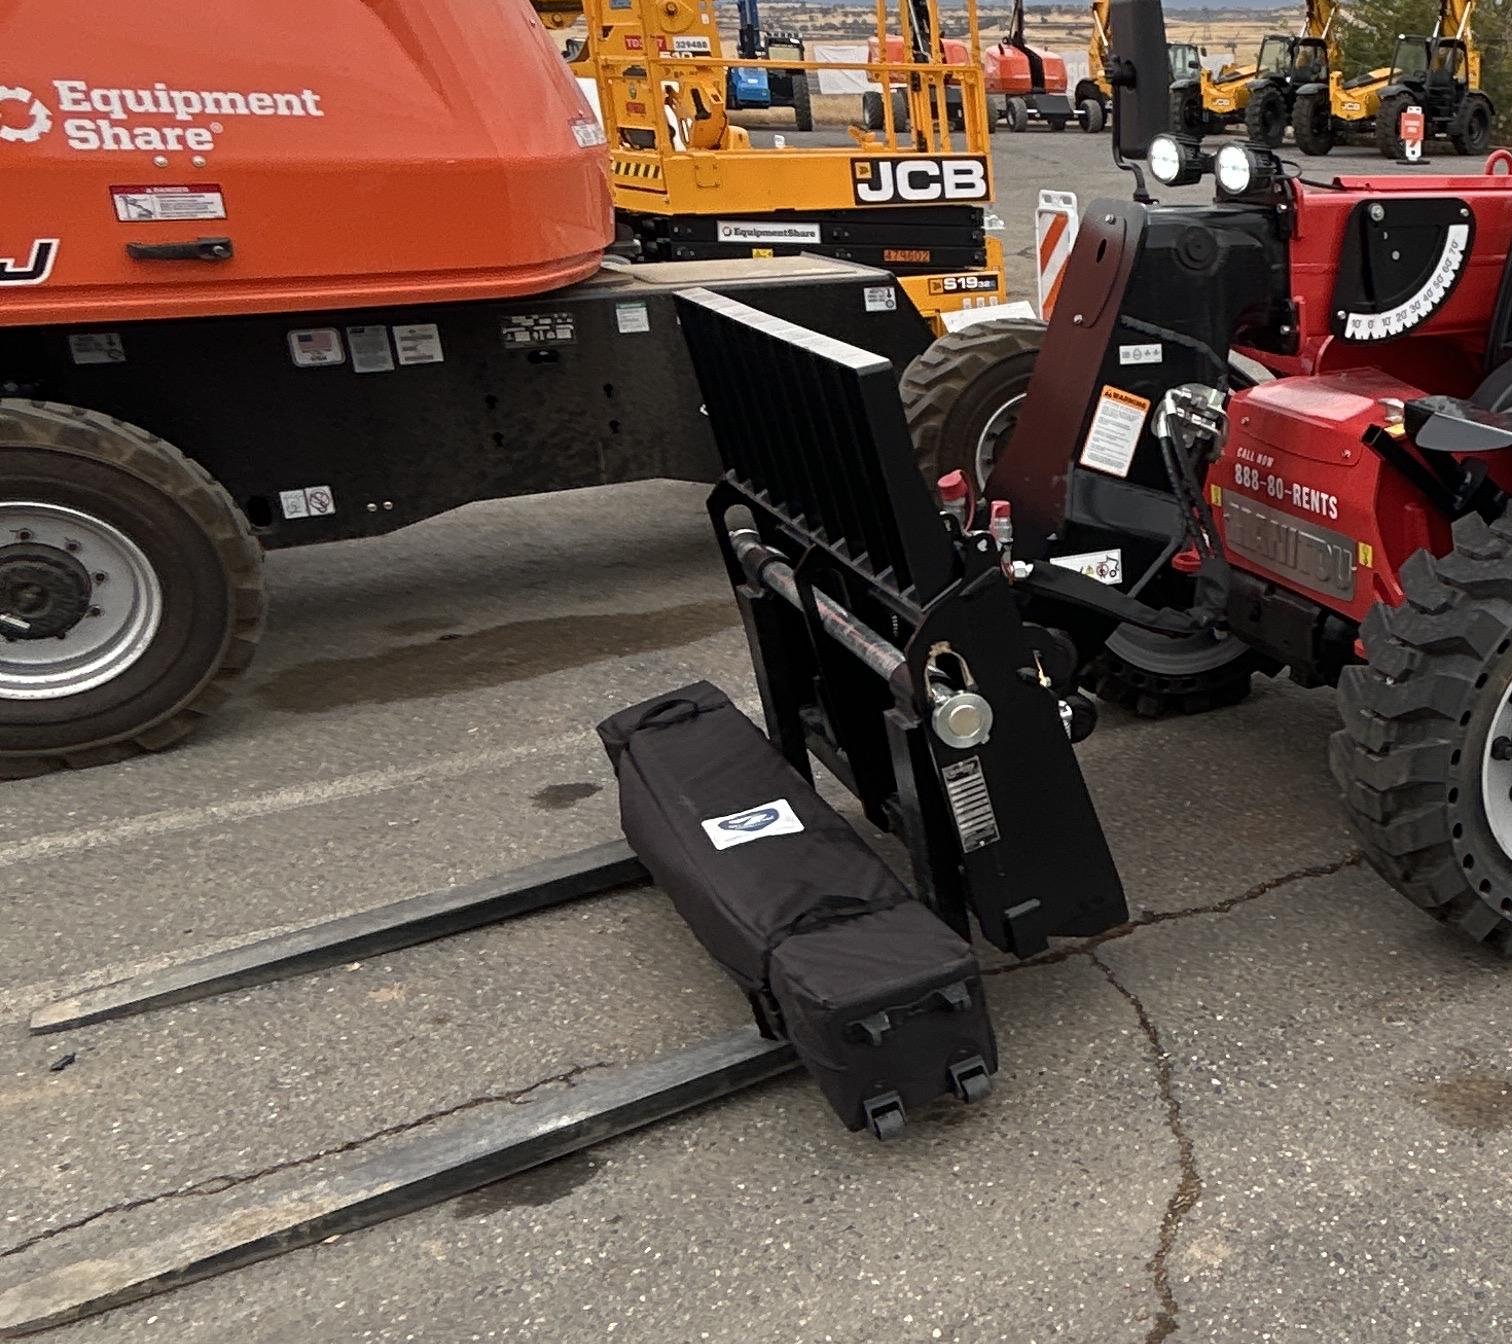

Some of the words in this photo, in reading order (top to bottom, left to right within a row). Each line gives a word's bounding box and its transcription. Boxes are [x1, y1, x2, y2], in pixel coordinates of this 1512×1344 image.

[53, 80, 324, 121] Equipment
[857, 159, 987, 201] JCB
[734, 227, 816, 238] EquipmentShare
[1112, 391, 1147, 411] WARNING
[1237, 447, 1254, 462] CALL
[1257, 453, 1275, 468] NOW
[1235, 463, 1338, 520] 888-80-RENTS
